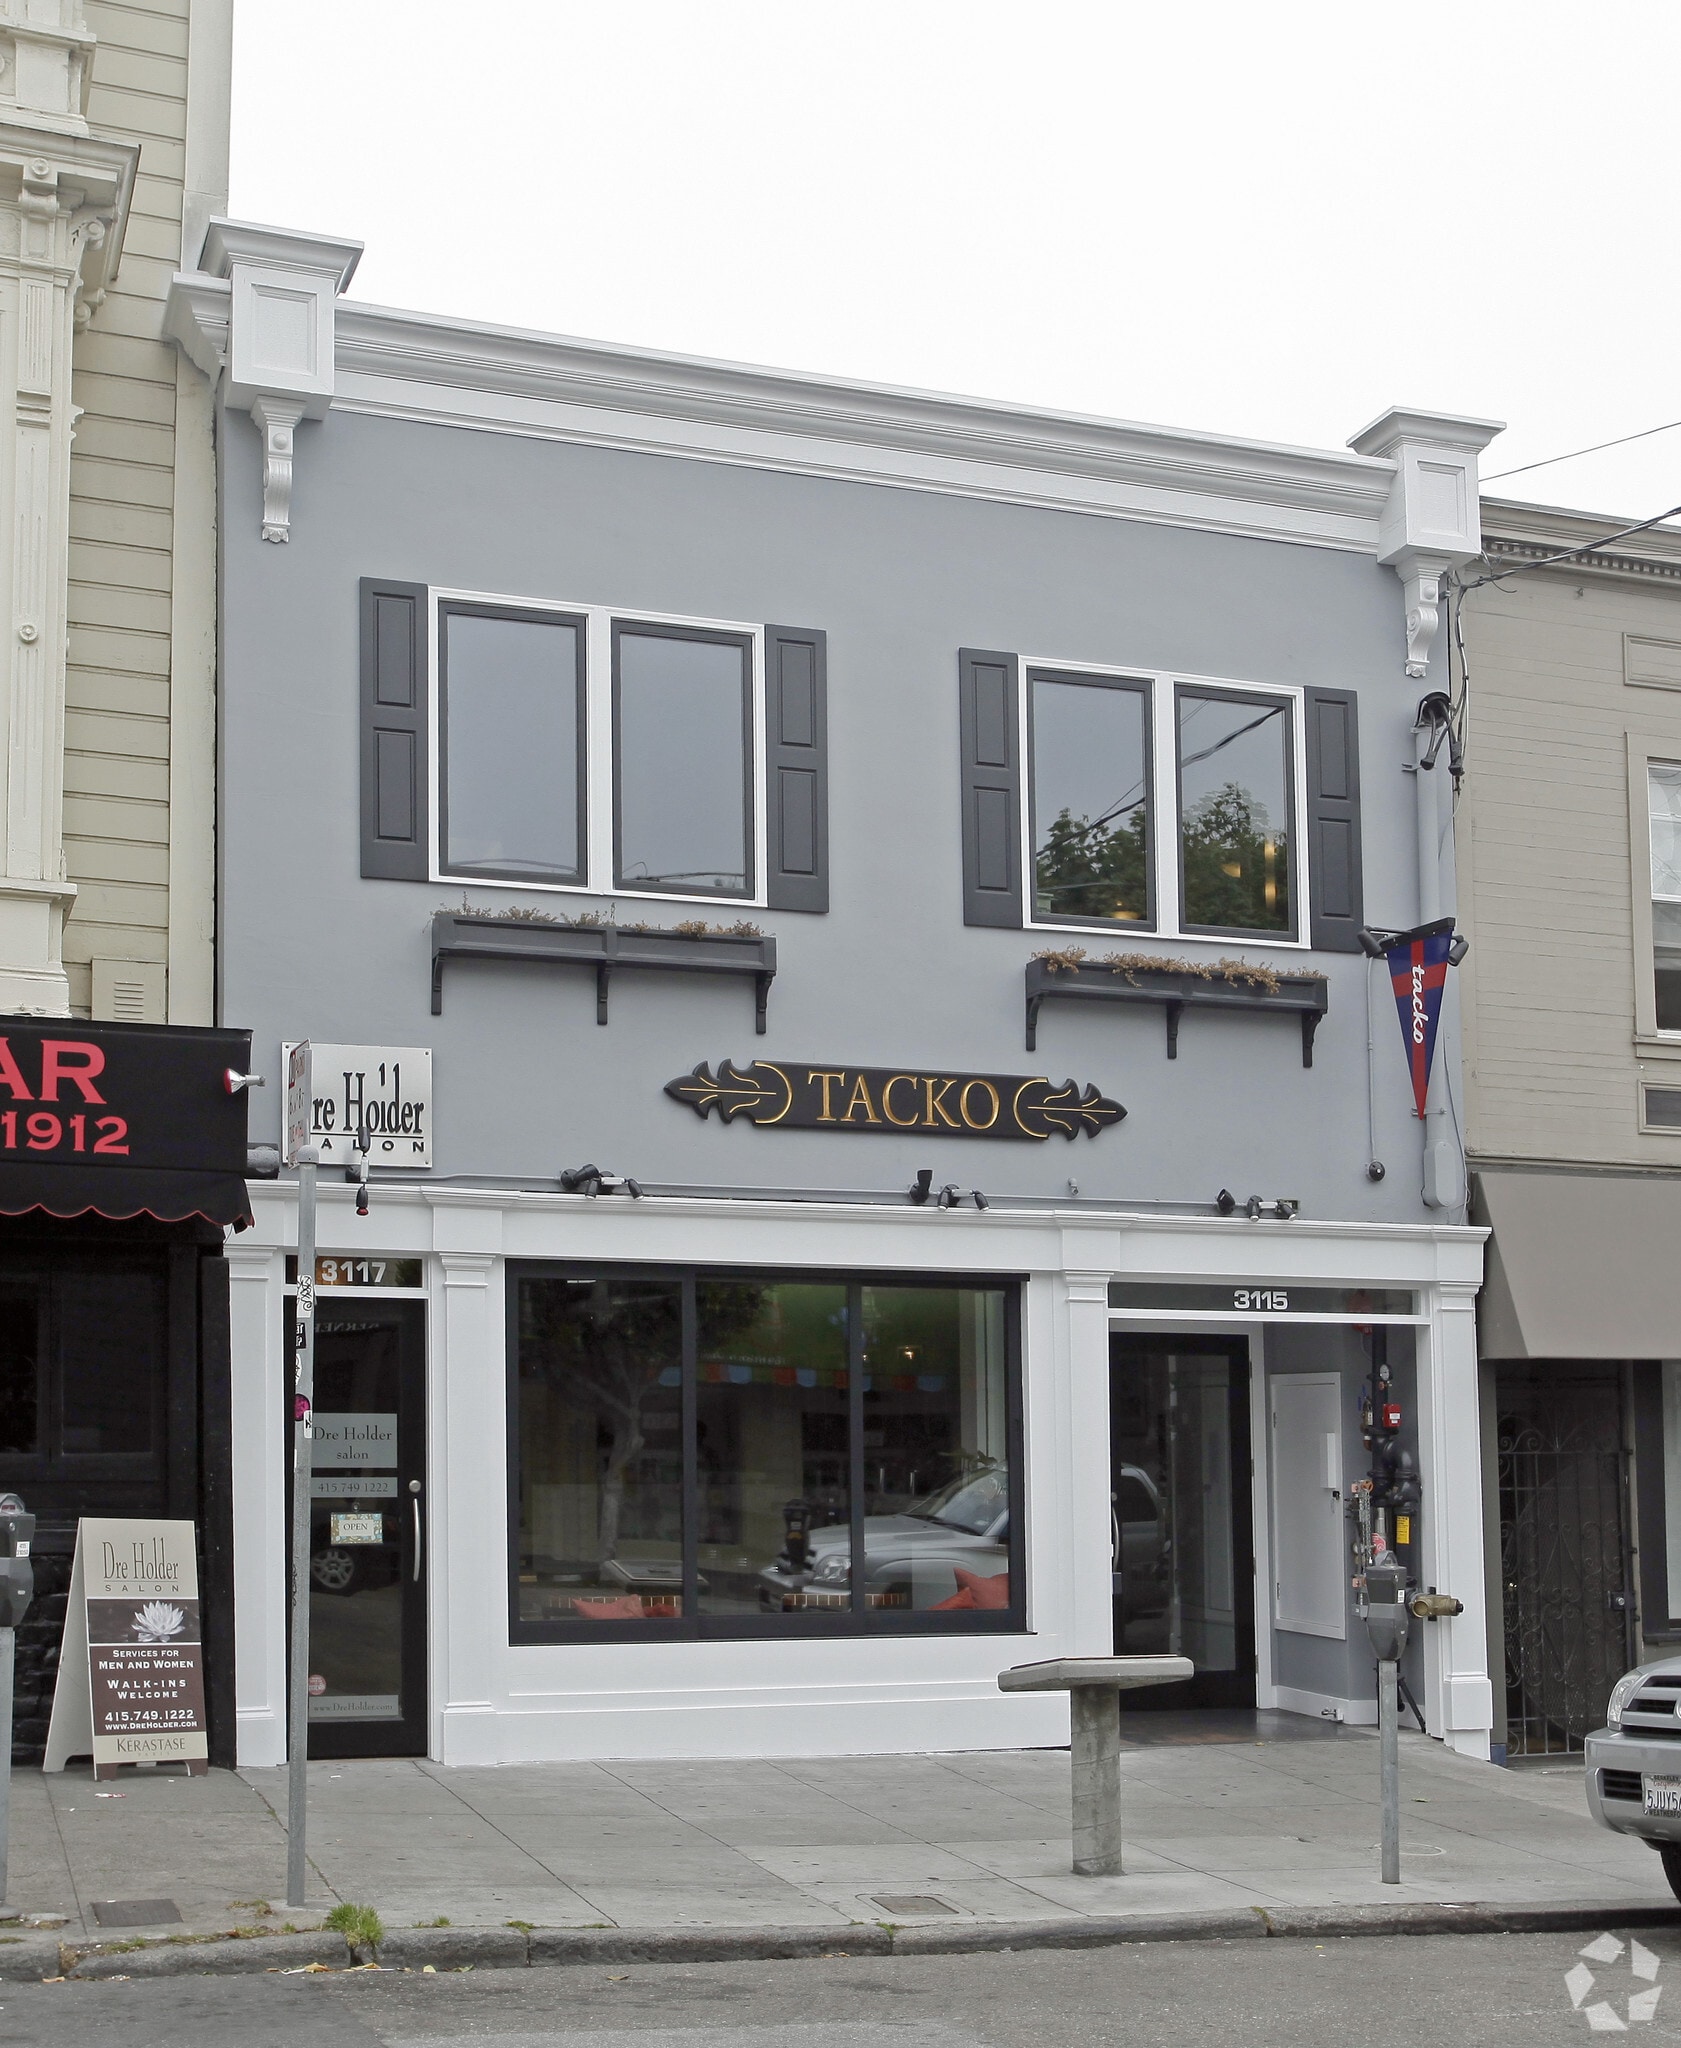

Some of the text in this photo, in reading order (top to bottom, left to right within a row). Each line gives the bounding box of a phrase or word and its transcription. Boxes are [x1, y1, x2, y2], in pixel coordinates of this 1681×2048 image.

[1412, 964, 1429, 1044] tacko
[312, 1097, 336, 1131] re
[343, 1062, 425, 1134] Holder
[808, 1070, 1000, 1130] TACKO
[1, 1111, 129, 1155] 1912
[320, 1137, 425, 1152] ALON
[321, 1260, 387, 1283] 3117
[1233, 1290, 1288, 1310] 3115
[313, 1425, 392, 1440] Dre Holder
[336, 1445, 369, 1460] salon
[318, 1482, 388, 1493] 415 749 1222
[343, 1523, 368, 1531] OPEN
[102, 1537, 179, 1580] Dre Holder
[105, 1584, 179, 1593] SALON
[113, 1649, 158, 1658] SERVICES
[98, 1660, 194, 1670] MEN AND WOMEN
[107, 1679, 187, 1689] WALK-INS
[117, 1691, 178, 1700] WELCOME
[105, 1709, 195, 1722] 415.749.1222
[1647, 1789, 1681, 1811] 5JUY5
